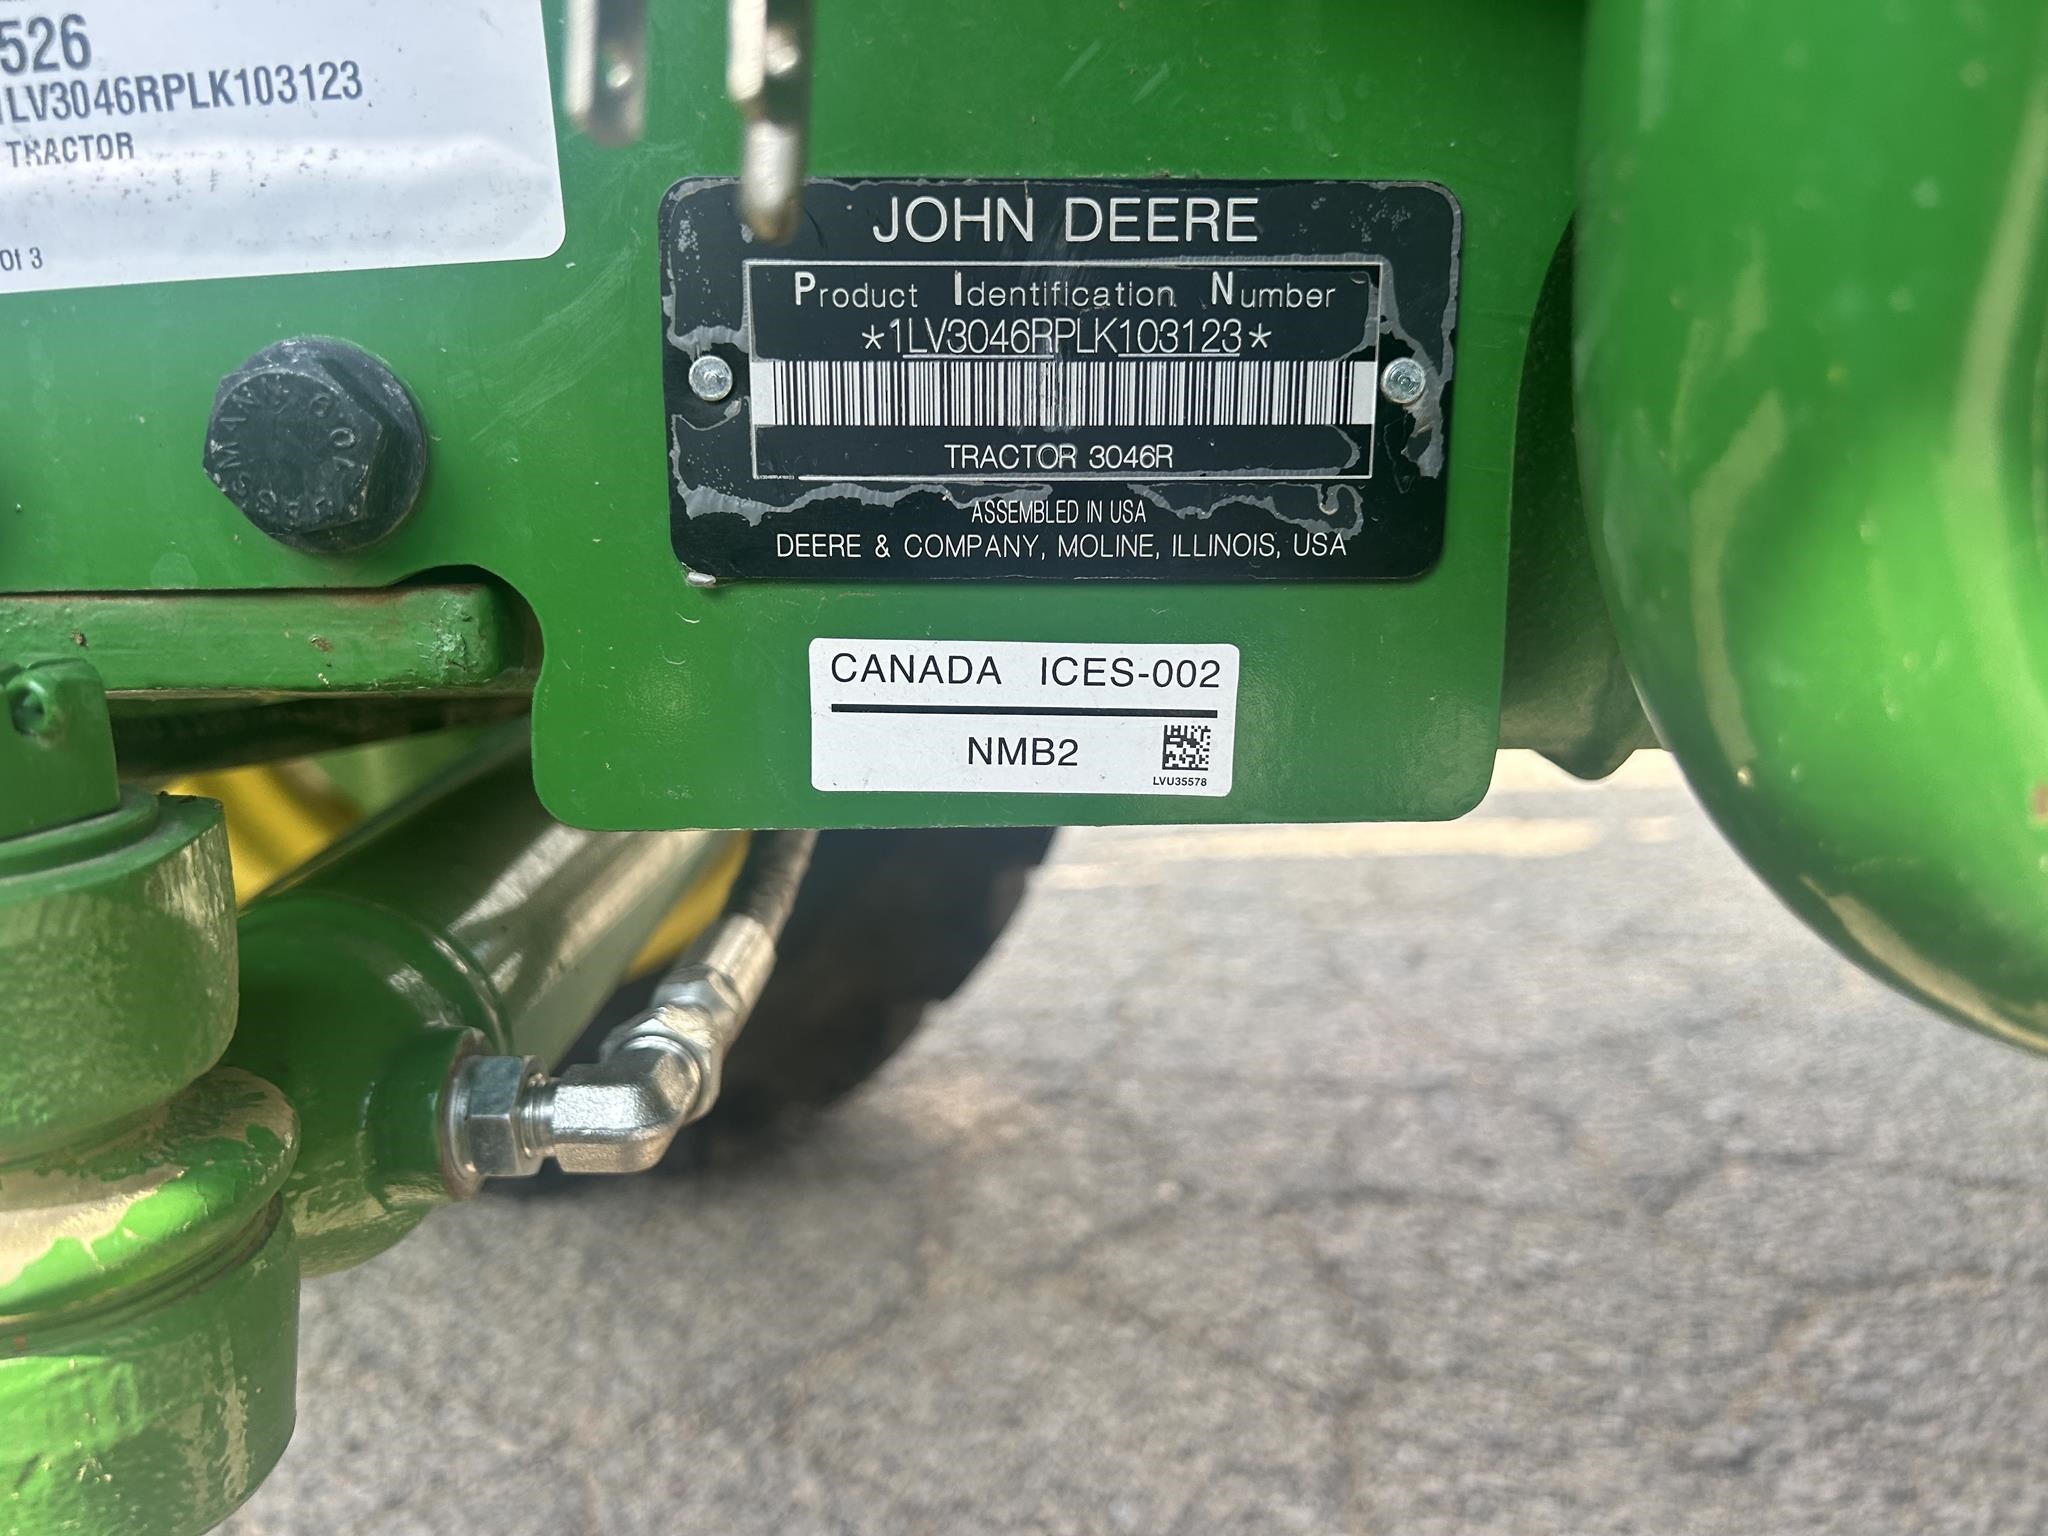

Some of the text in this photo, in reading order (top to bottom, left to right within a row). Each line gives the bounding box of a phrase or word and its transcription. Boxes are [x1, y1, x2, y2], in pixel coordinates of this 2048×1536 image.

[5, 131, 134, 168] TRACTOR
[872, 196, 1259, 243] JOHN DEERE
[29, 246, 43, 270] 3
[794, 270, 1336, 309] Product Identification Number
[943, 443, 1173, 470] TRACTOR 3046R
[971, 499, 1147, 525] ASSEMBLED IN USA
[776, 531, 1347, 562] DEERE & COMPANY, MOLINE, ILLINOIS, USA
[831, 652, 1220, 688] CANADA ICES-002
[968, 736, 1079, 767] NMB2
[1152, 776, 1207, 787] LVU35578
